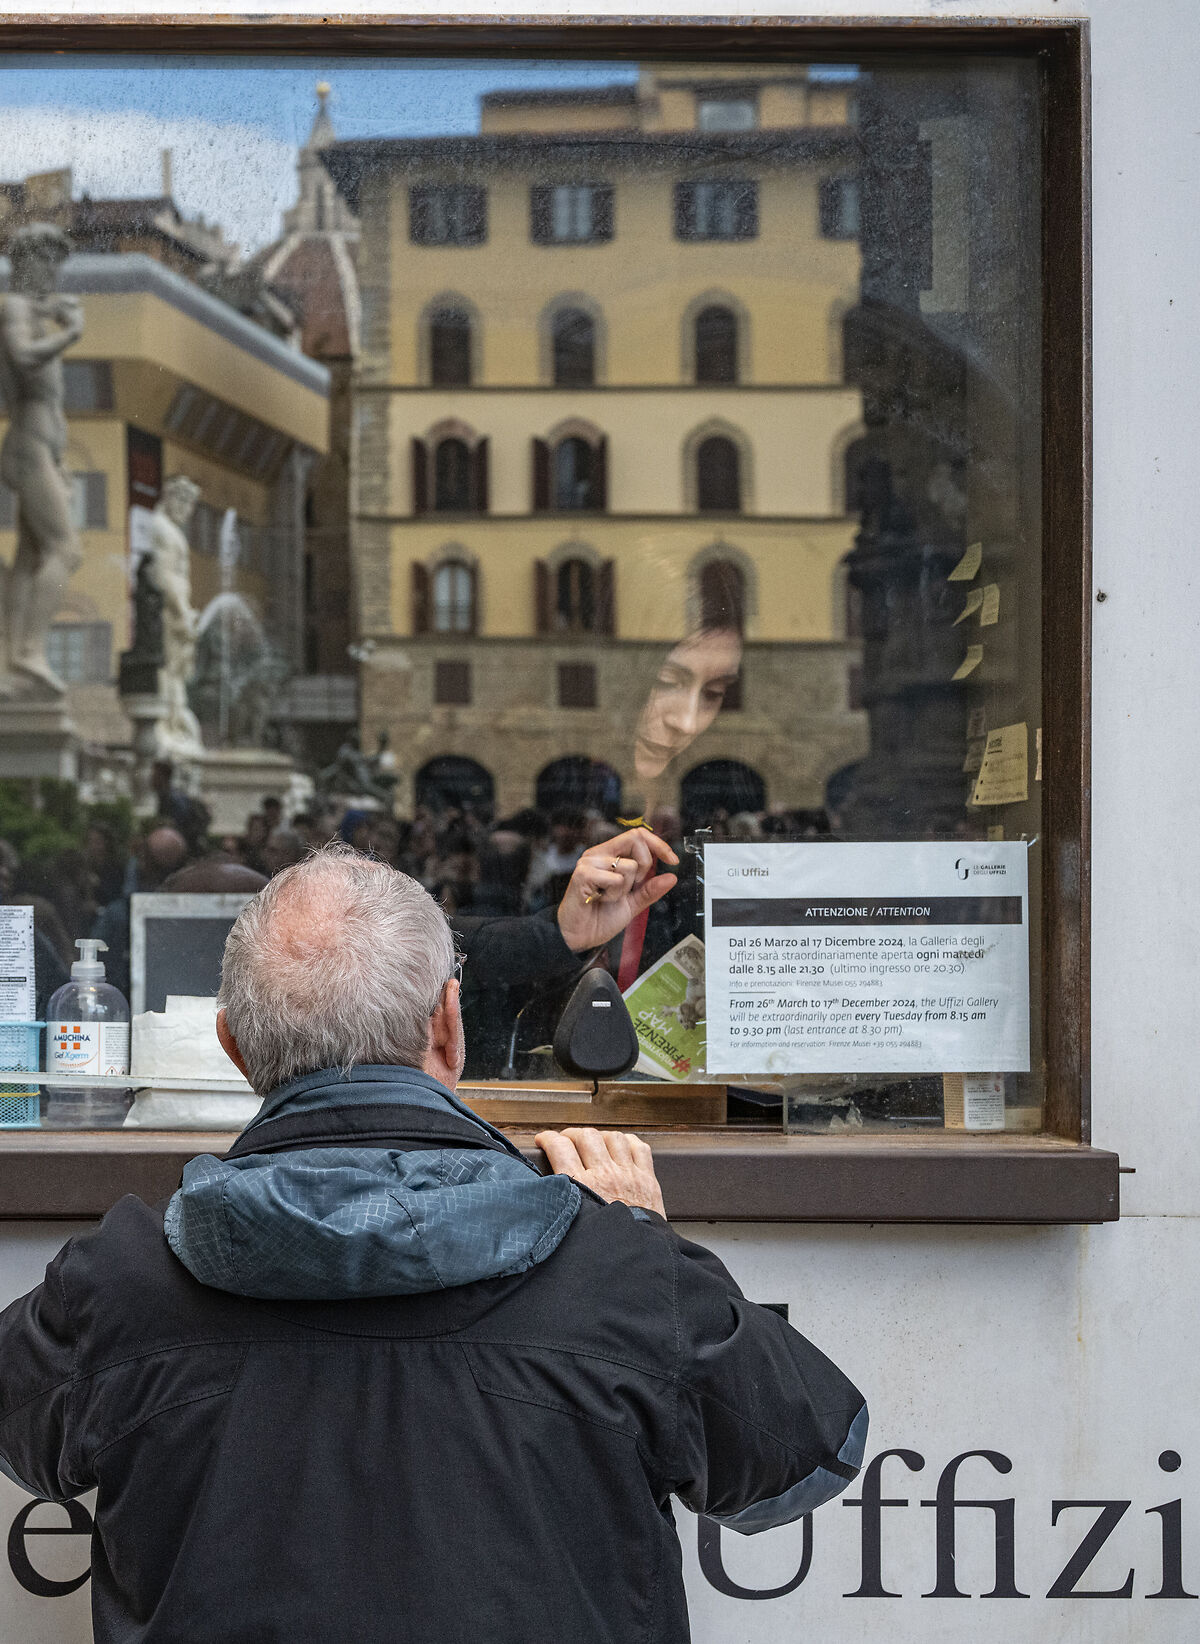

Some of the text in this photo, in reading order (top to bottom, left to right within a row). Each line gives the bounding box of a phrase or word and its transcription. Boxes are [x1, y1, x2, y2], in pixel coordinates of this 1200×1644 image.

[727, 867, 769, 877] Gli Uffizi
[805, 907, 868, 917] ATTENZIONE
[876, 907, 930, 916] ATTENTION
[729, 935, 985, 948] Dal 26 Marzo al 17 Dicembre 2024, la Galleria degli
[729, 949, 984, 962] Uffizi sarà straordinariamente aperta ogni martedì
[729, 964, 754, 974] dalle
[757, 965, 776, 975] 8.15
[778, 964, 797, 974] alle
[800, 965, 825, 975] 21.30
[830, 963, 867, 975] (ultimo
[869, 964, 911, 975] ingresso
[914, 965, 930, 973] ore
[729, 980, 743, 989] Info
[730, 999, 754, 1008] From
[777, 998, 808, 1008] March
[811, 999, 821, 1008] to
[842, 997, 890, 1007] December
[892, 999, 918, 1008] 2024,
[921, 997, 936, 1007] the
[939, 997, 964, 1009] Uffizi
[966, 996, 999, 1009] Gallery
[730, 1010, 986, 1023] will be extraordinarily open every Tuesday from 8.15 am
[638, 1010, 673, 1036] MAP
[730, 1026, 740, 1035] to
[743, 1026, 764, 1036] 9.30
[766, 1026, 781, 1037] pm
[784, 1025, 804, 1037] (last
[807, 1025, 846, 1035] entrance
[849, 1026, 859, 1034] at
[861, 1025, 882, 1035] 8.30
